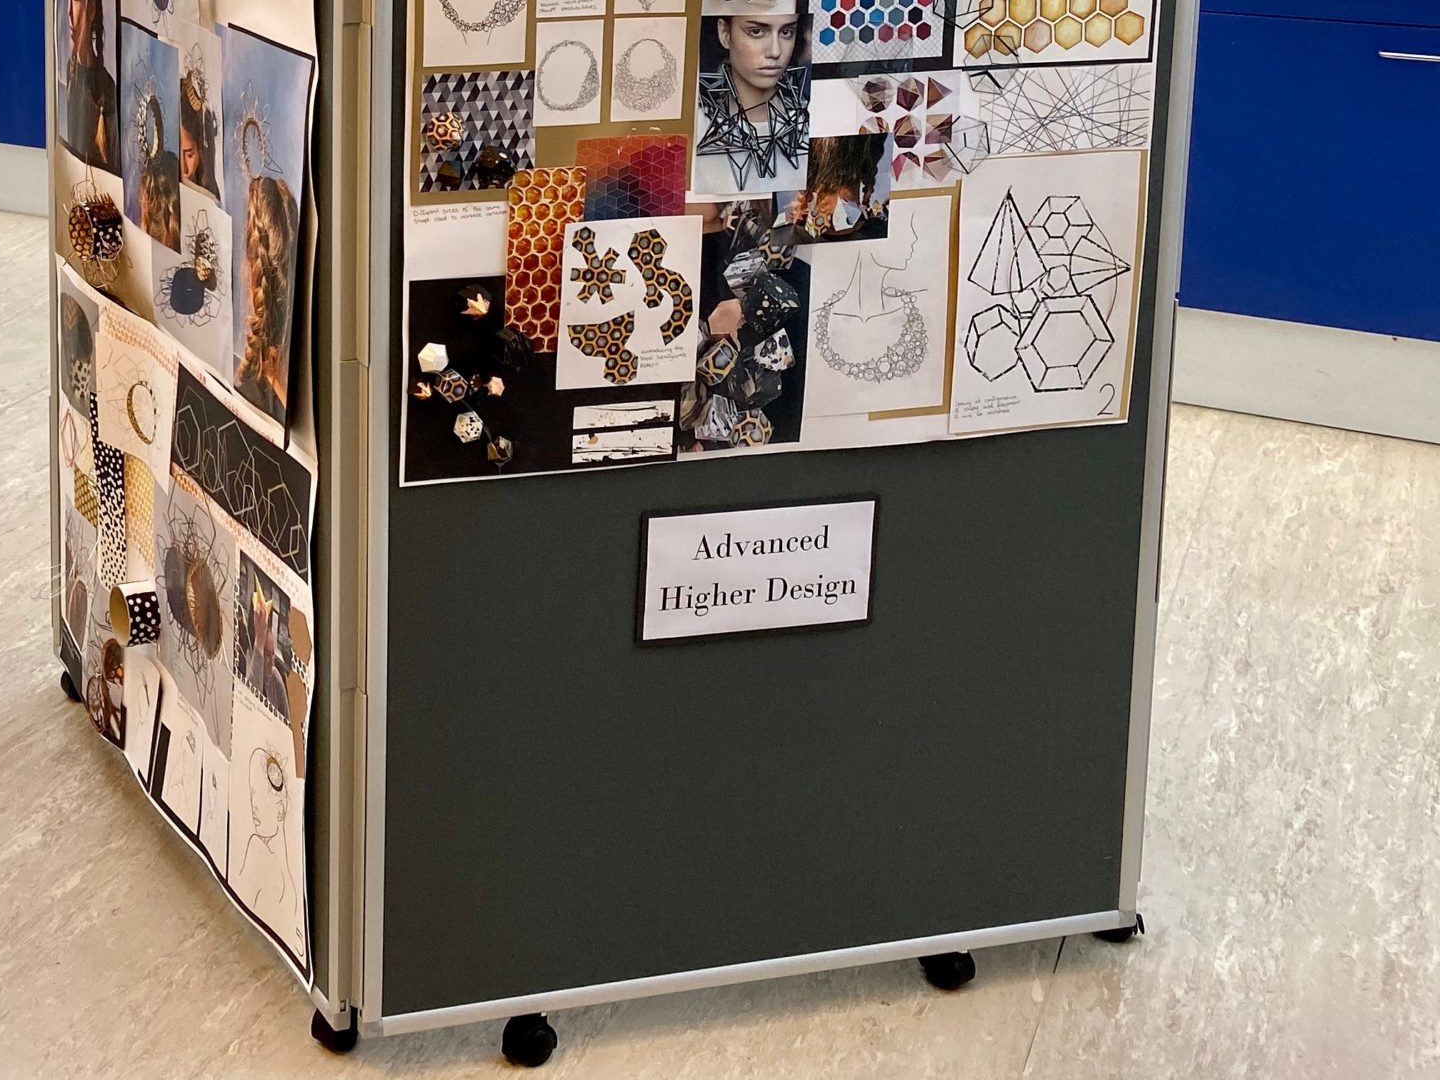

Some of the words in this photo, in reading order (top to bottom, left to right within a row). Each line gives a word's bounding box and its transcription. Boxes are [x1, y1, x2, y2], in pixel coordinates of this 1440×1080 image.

[1096, 382, 1116, 417] 2
[692, 524, 830, 561] Advanced
[658, 581, 757, 617] Higher
[765, 574, 857, 606] Design
